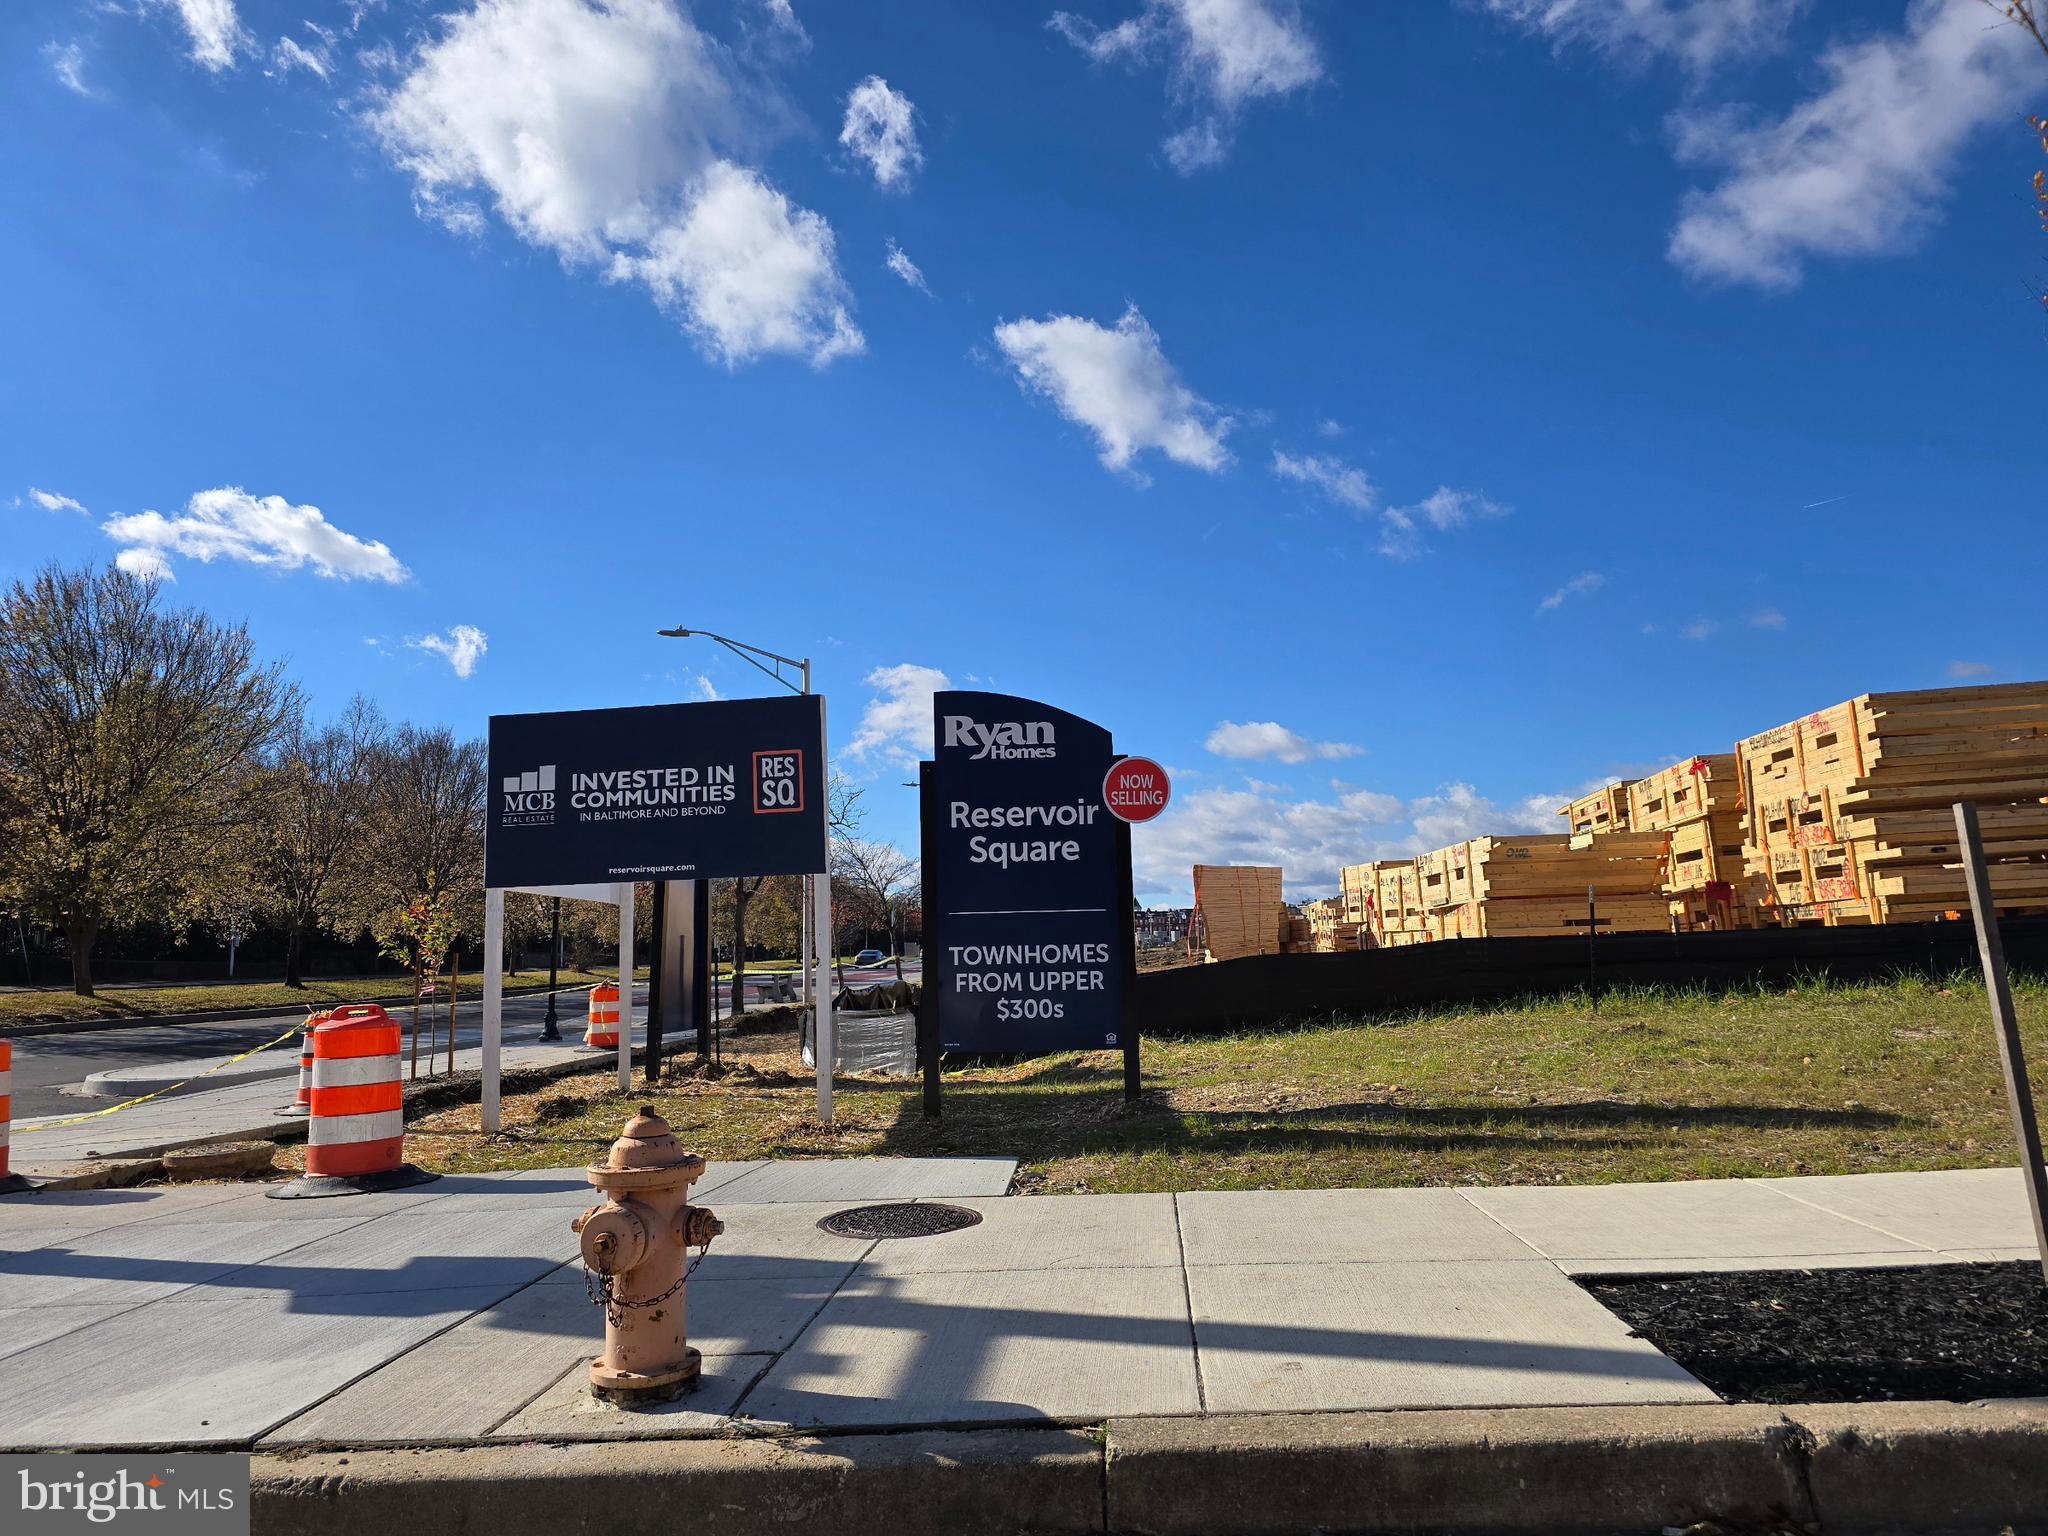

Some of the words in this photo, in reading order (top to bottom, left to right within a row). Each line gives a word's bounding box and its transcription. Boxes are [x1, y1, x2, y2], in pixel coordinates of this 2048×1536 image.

[943, 715, 1056, 760] Ryan
[990, 746, 1057, 760] Homes
[571, 768, 699, 792] INVESTED
[706, 764, 735, 784] IN
[761, 756, 795, 778] RES
[761, 779, 797, 807] SQ
[1119, 774, 1154, 789] NOW
[503, 792, 556, 812] MCB
[570, 784, 736, 809] COMMUNITIES
[1110, 790, 1163, 806] SELLING
[502, 816, 523, 824] REAL
[525, 814, 555, 822] ESTATE
[579, 812, 592, 822] IN
[594, 809, 652, 821] BALTIMORE
[653, 806, 679, 818] AND
[681, 804, 726, 817] BEYOND
[951, 798, 1099, 829] Reservoir
[969, 836, 1080, 869] Square
[608, 863, 696, 875] reservoirsquare.com
[949, 943, 1109, 966] TOWNHOMES
[956, 972, 1022, 993] FROM
[1029, 970, 1104, 991] UPPER
[997, 997, 1064, 1021] $300s
